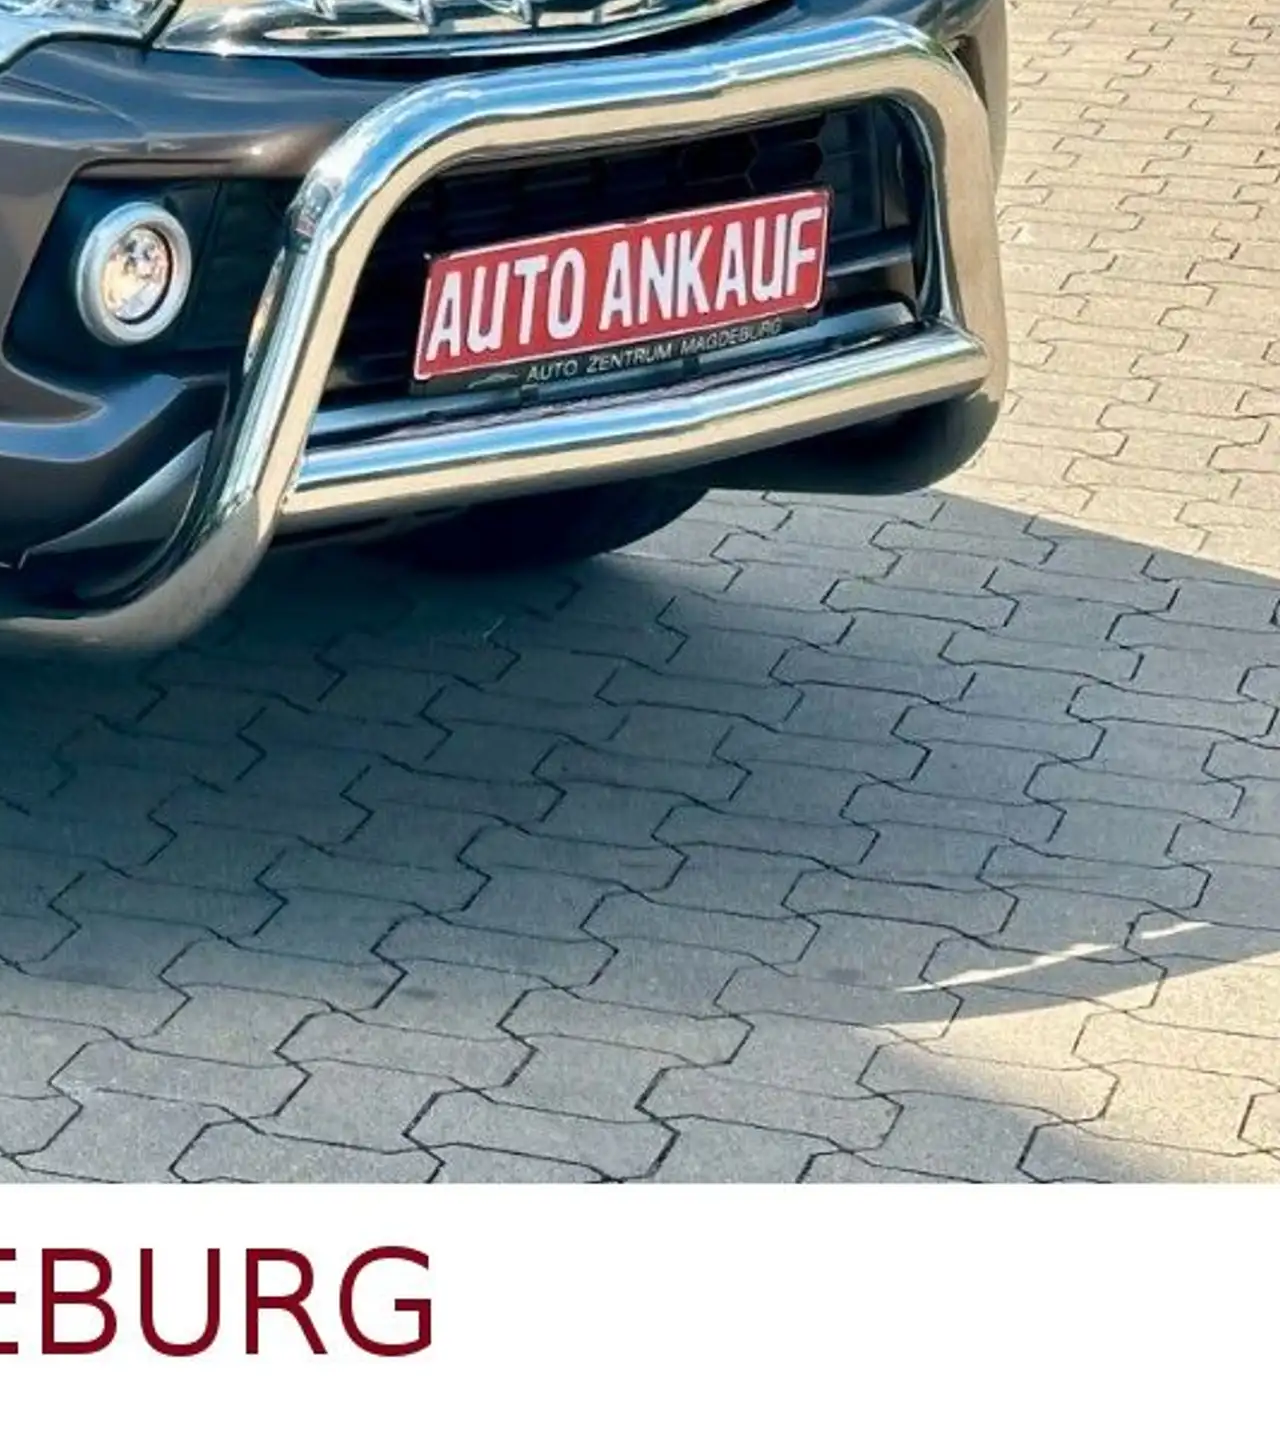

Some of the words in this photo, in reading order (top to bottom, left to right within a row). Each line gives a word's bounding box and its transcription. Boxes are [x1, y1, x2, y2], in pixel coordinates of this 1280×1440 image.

[426, 247, 587, 361] AUTO
[599, 206, 823, 331] ANKAUF
[526, 359, 579, 383] AUTO
[585, 340, 673, 373] ZENTRUM
[681, 317, 782, 357] MAGDEBURG
